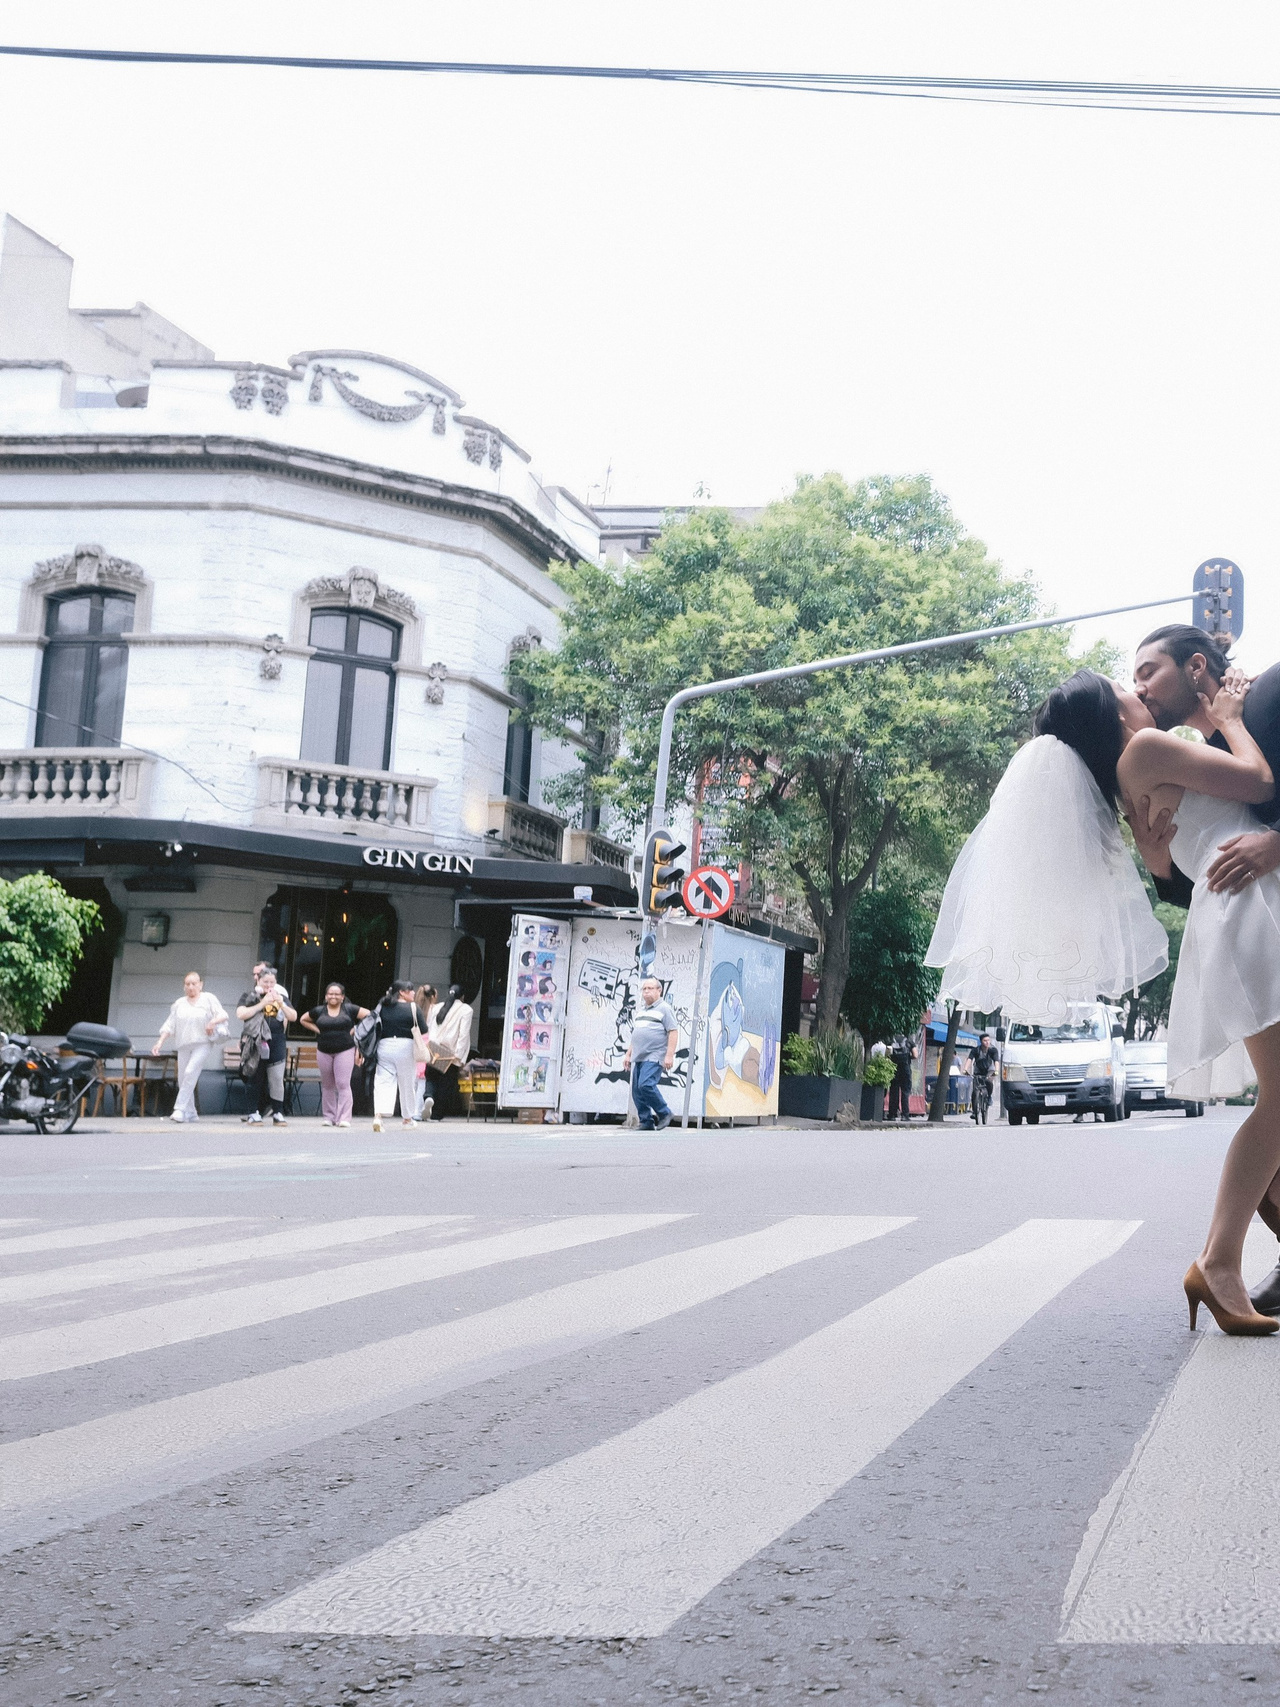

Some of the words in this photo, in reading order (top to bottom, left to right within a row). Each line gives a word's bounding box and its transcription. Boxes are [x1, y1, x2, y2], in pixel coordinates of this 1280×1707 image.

[363, 846, 419, 869] GIN
[422, 852, 475, 874] GIN
[729, 907, 740, 922] GIN
